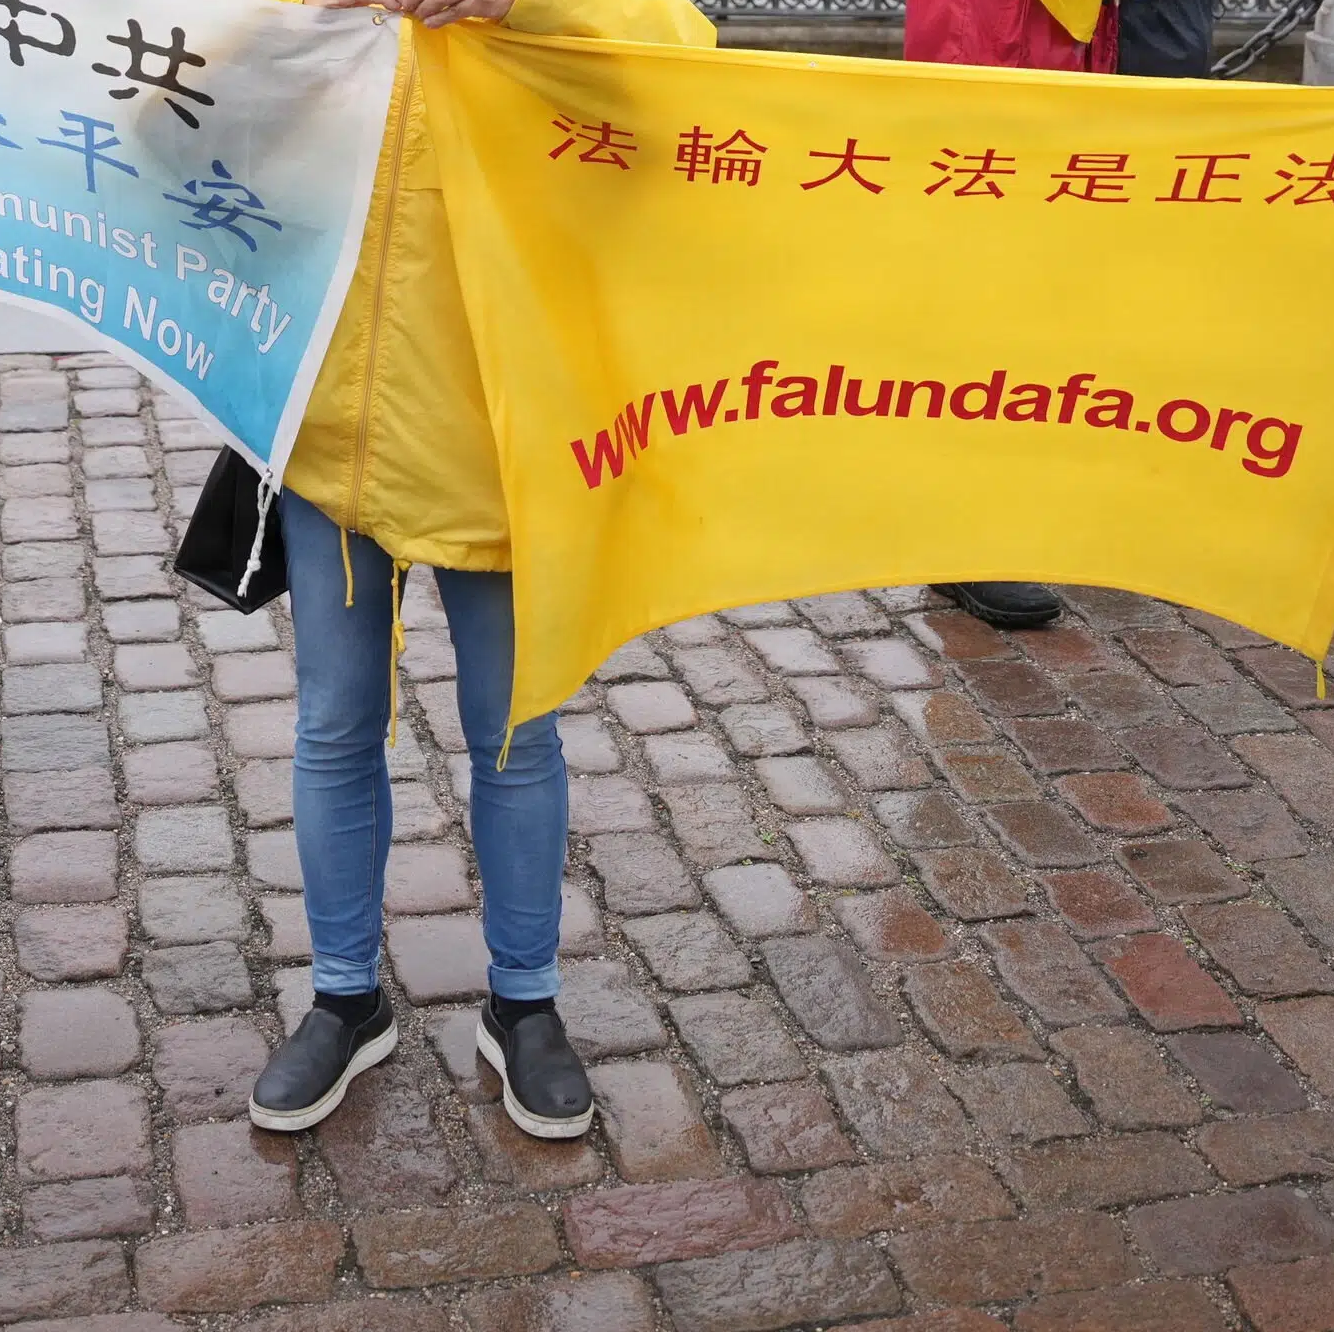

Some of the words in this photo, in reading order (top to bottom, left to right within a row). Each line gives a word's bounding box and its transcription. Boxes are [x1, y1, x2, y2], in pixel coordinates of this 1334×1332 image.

[123, 284, 216, 381] Now
[175, 241, 292, 355] Party
[570, 360, 1304, 490] www.falundafa.org
